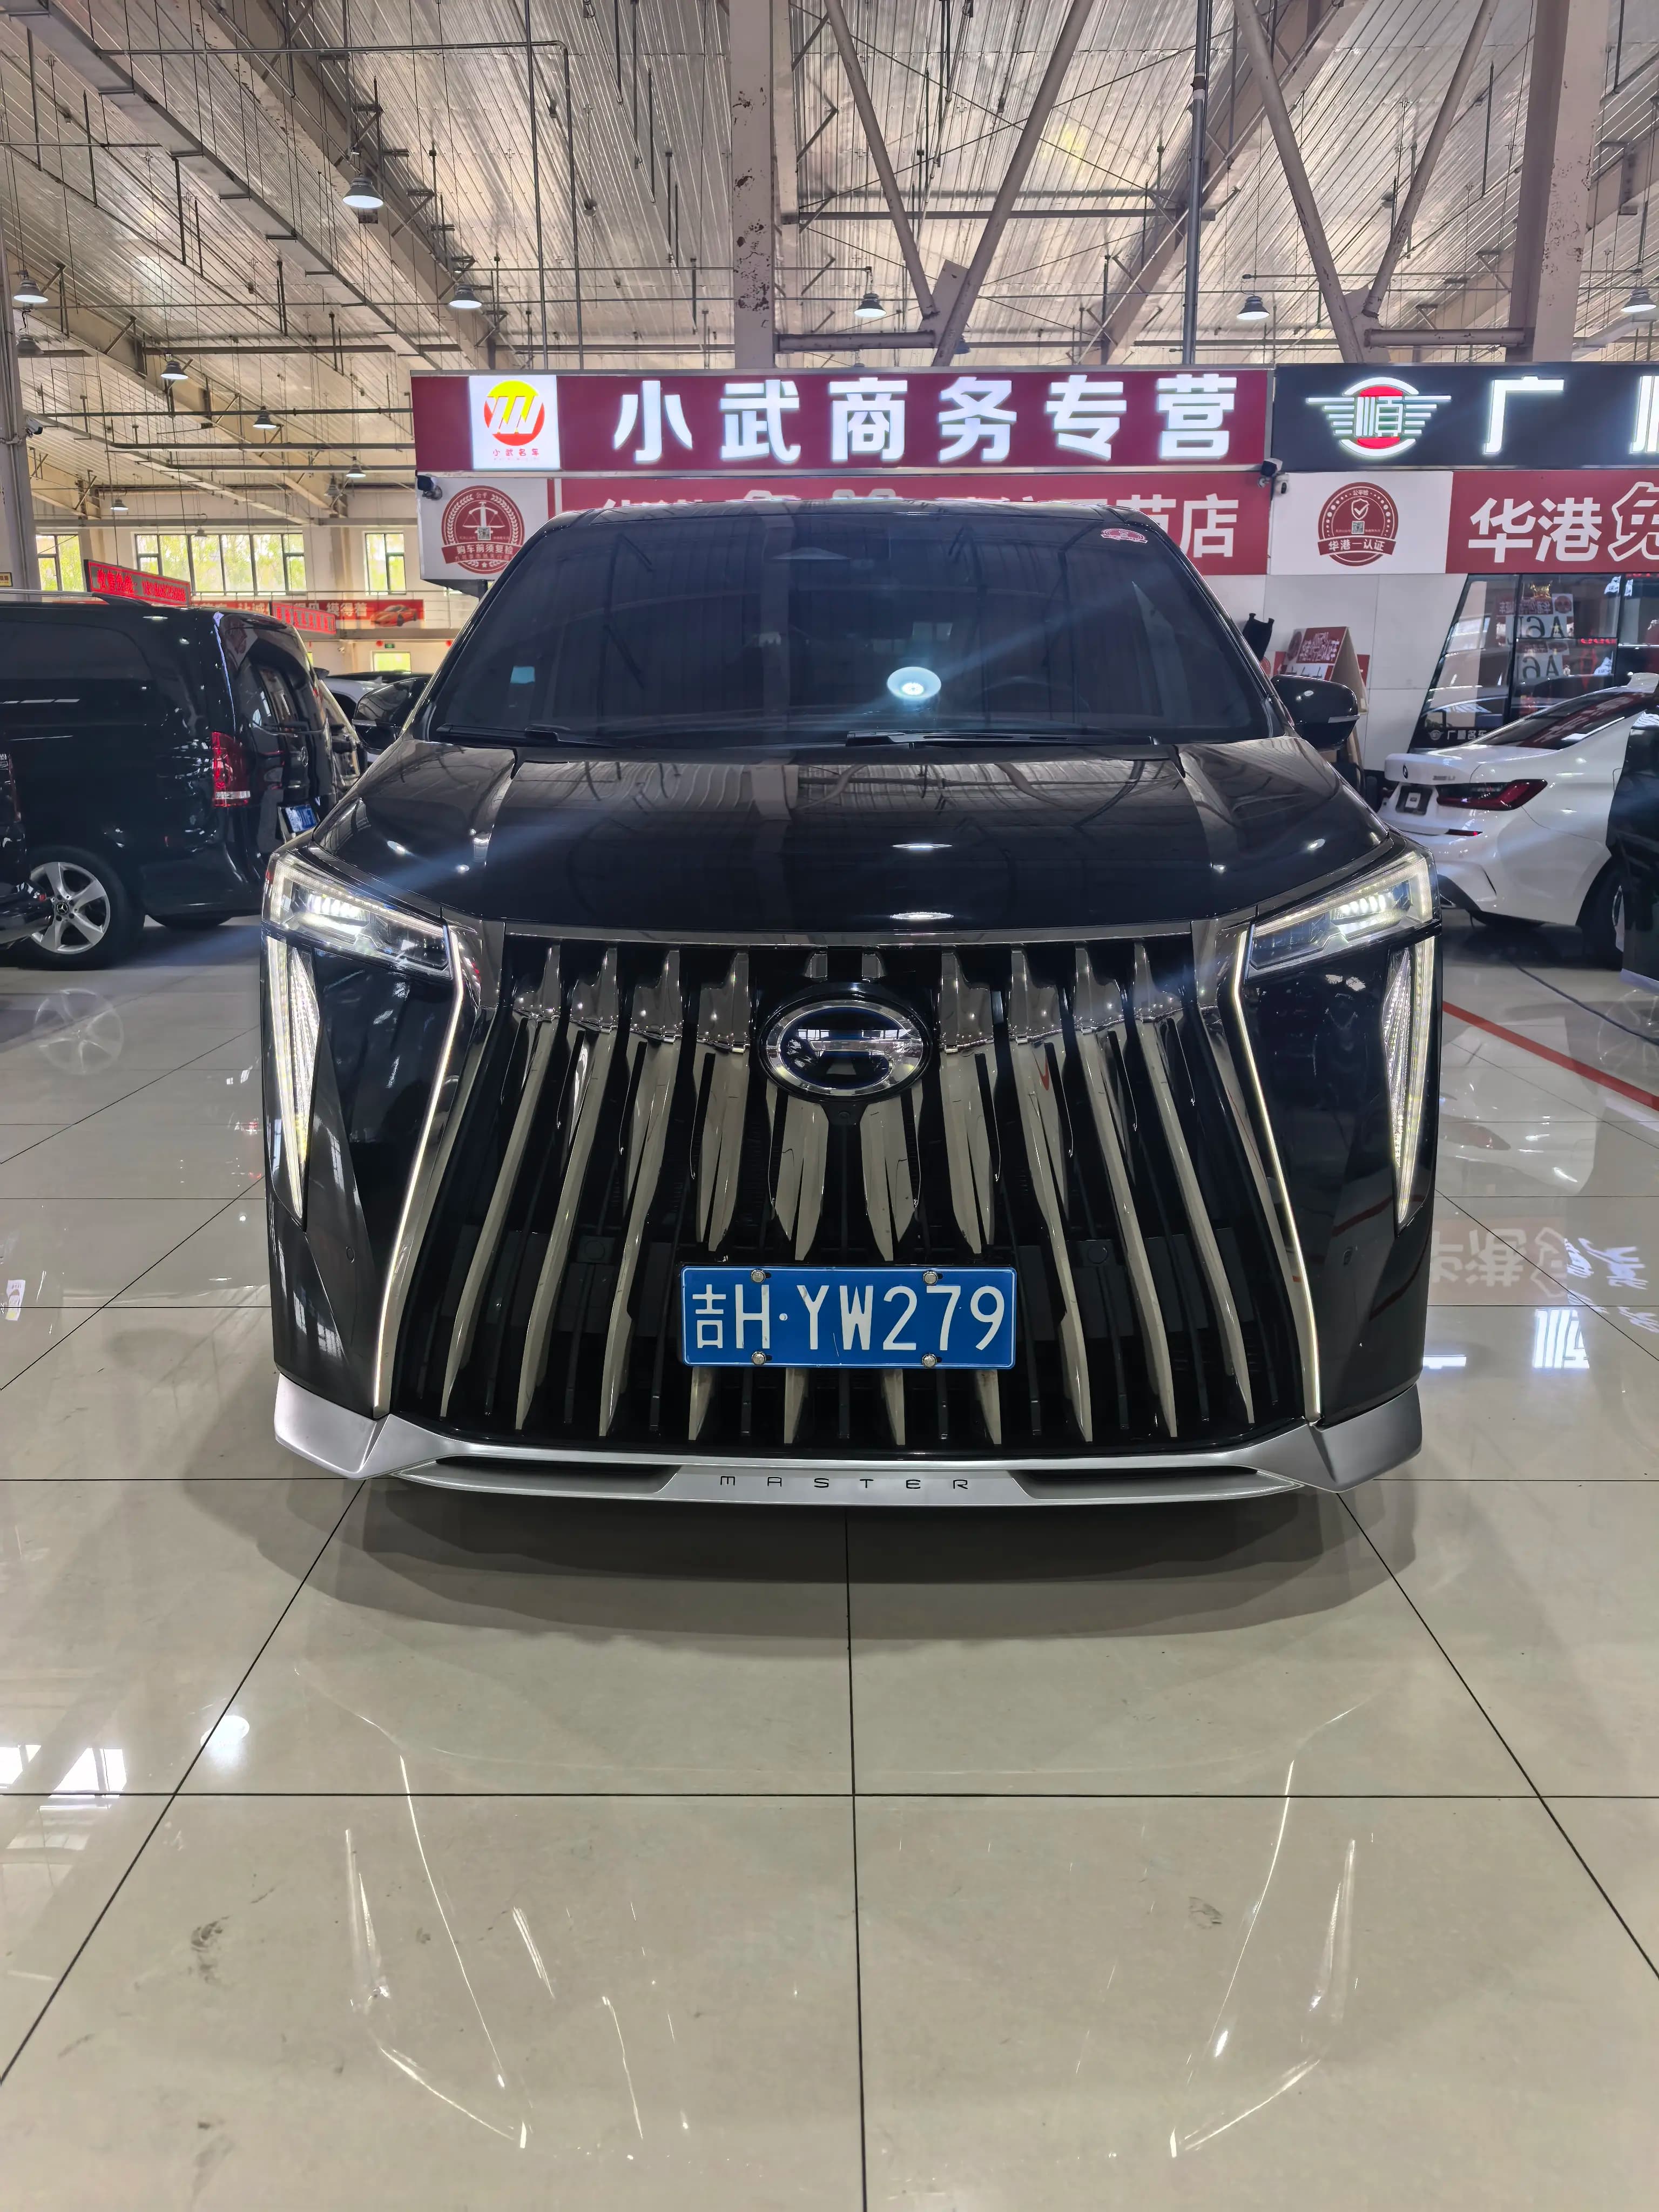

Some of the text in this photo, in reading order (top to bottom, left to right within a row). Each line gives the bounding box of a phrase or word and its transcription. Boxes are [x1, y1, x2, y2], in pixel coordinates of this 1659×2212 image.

[613, 374, 1238, 463] 小武商务专营
[493, 448, 539, 456] 小武名车
[1328, 539, 1386, 551] 华港一认证
[692, 1284, 1006, 1351] 吉H·YW279
[720, 1475, 969, 1490] MASTER
